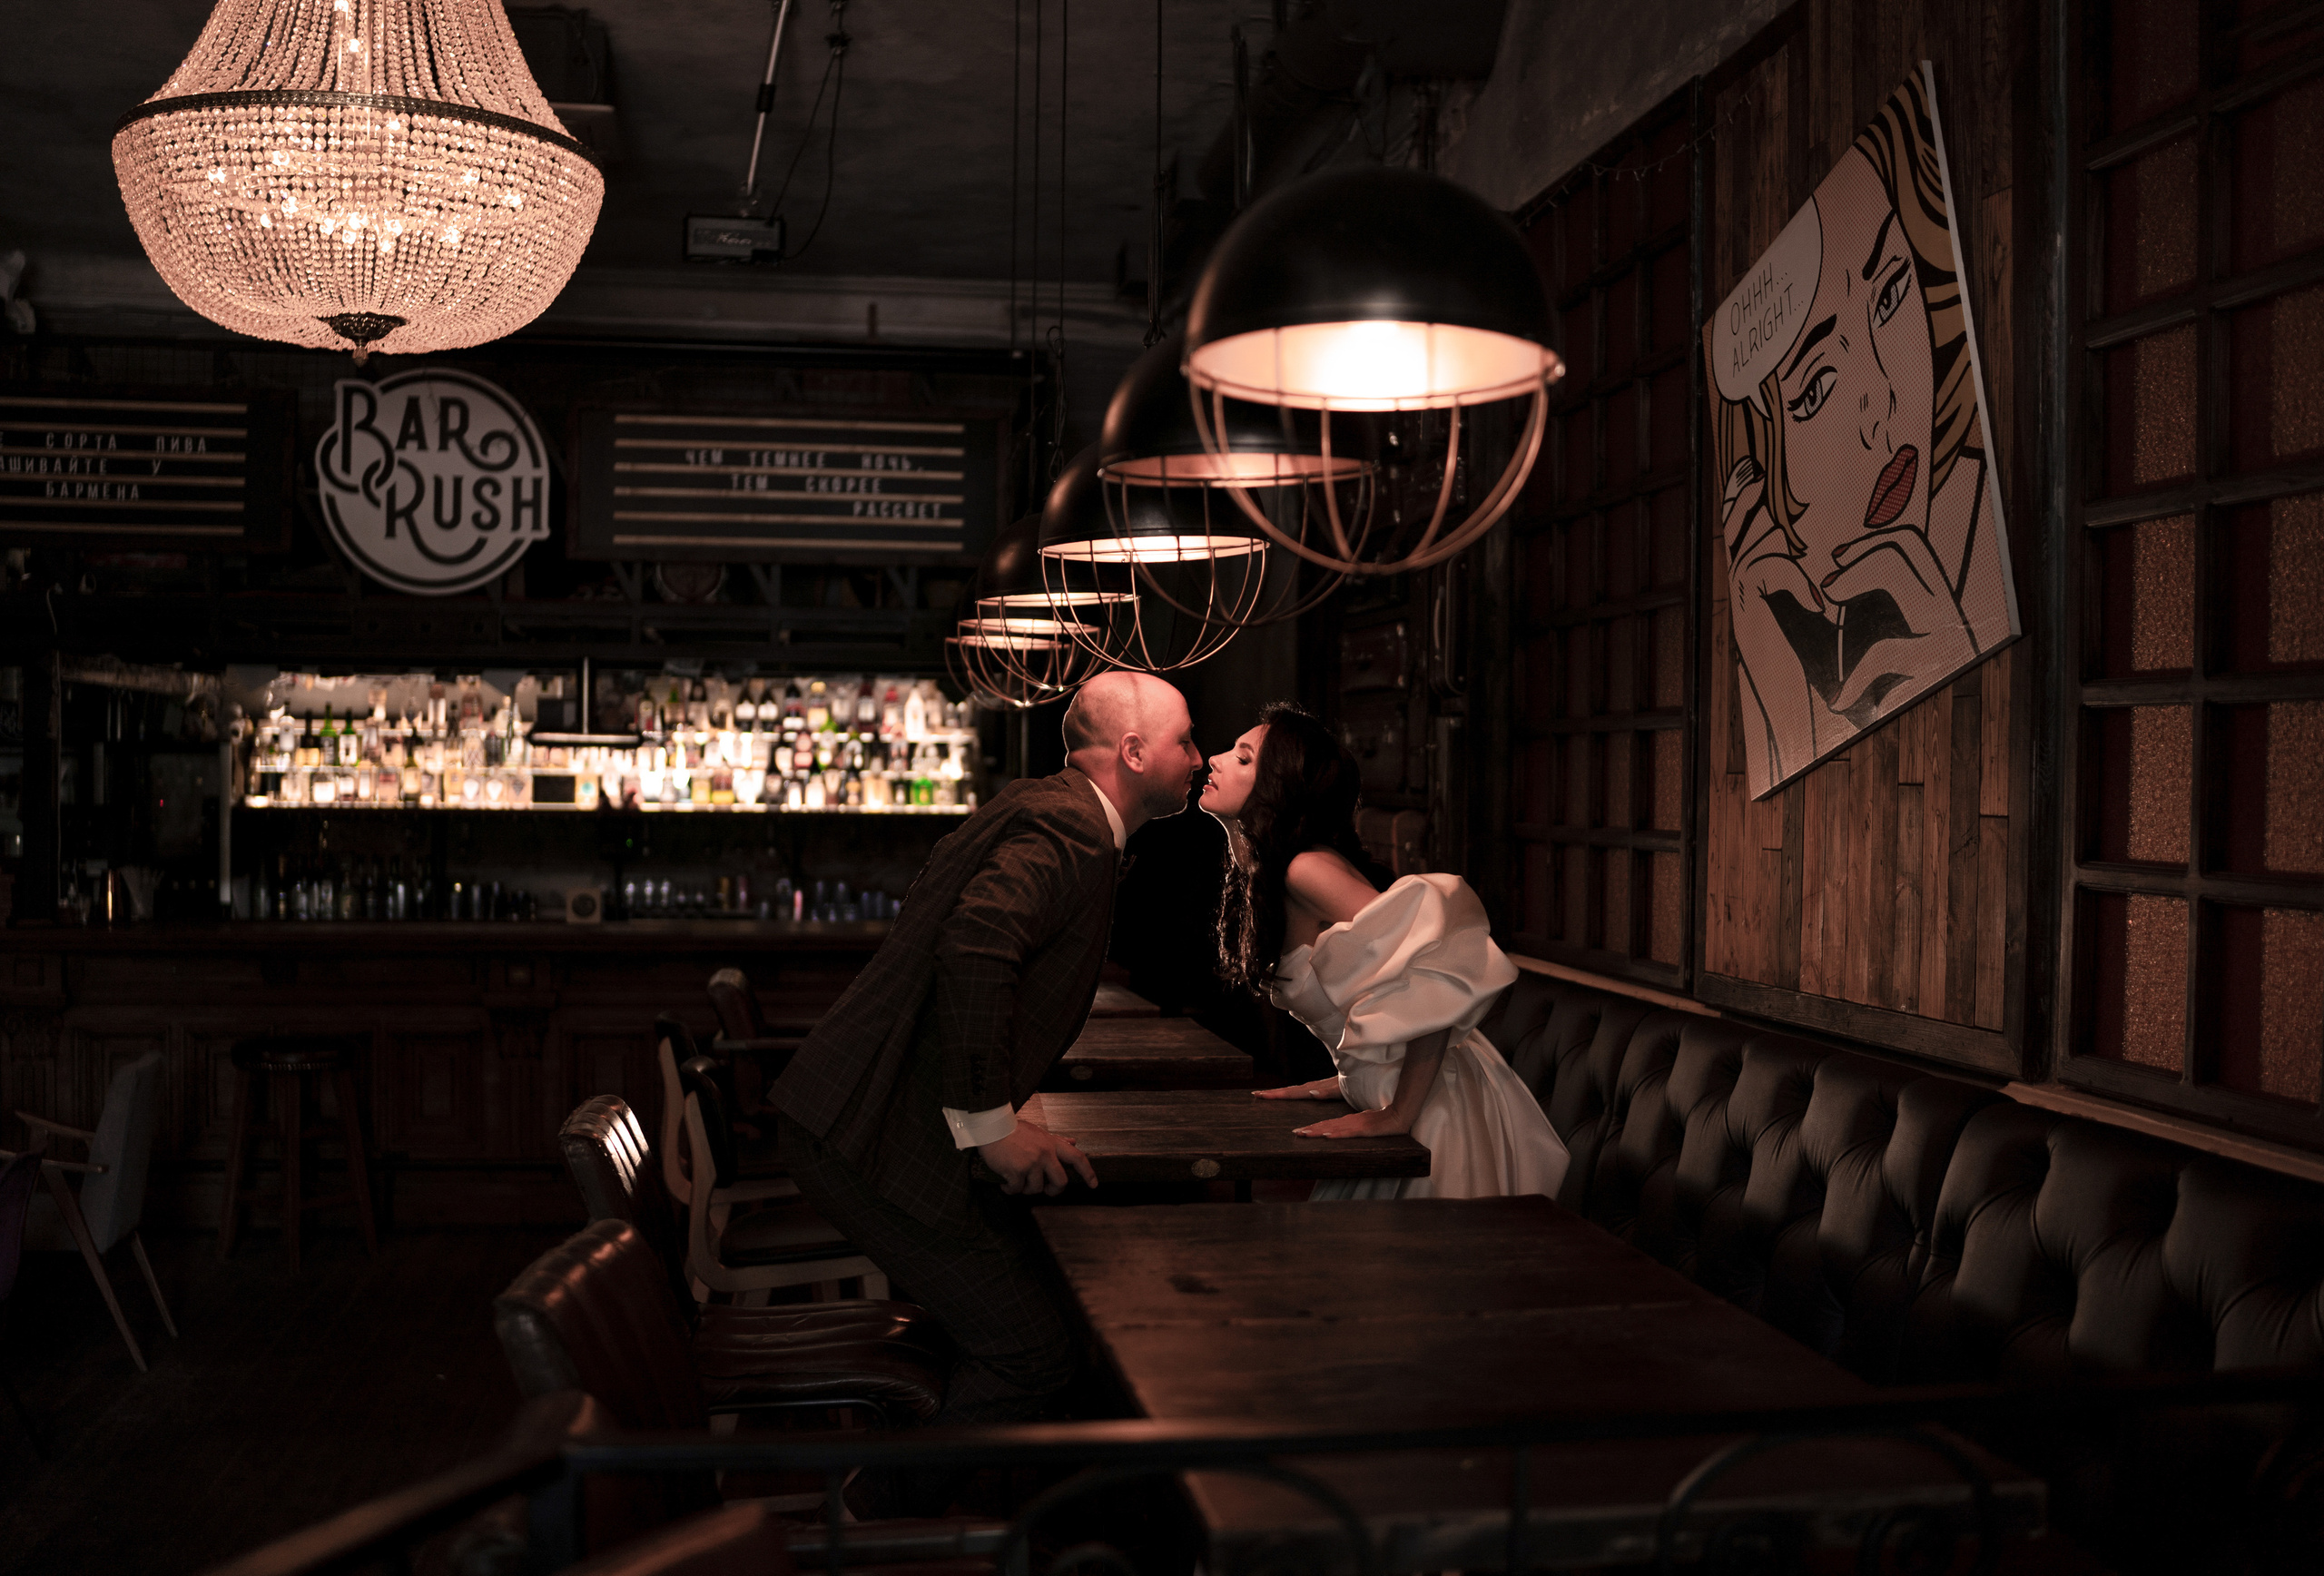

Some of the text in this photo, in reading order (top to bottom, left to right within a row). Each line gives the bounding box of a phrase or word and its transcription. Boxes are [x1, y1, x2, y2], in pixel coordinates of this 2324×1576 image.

[45, 431, 207, 453] СОРТА ПИВА
[320, 384, 519, 494] BAR
[152, 458, 162, 476] У
[685, 448, 724, 466] ЧЕМ
[749, 450, 826, 468] ТЕМНЕЕ
[45, 481, 139, 499] БАРМЕНА
[731, 473, 881, 493] ТЕМ СКОРЕЕ
[361, 458, 543, 565] RUSH
[852, 500, 940, 518] РАССВЕТ
